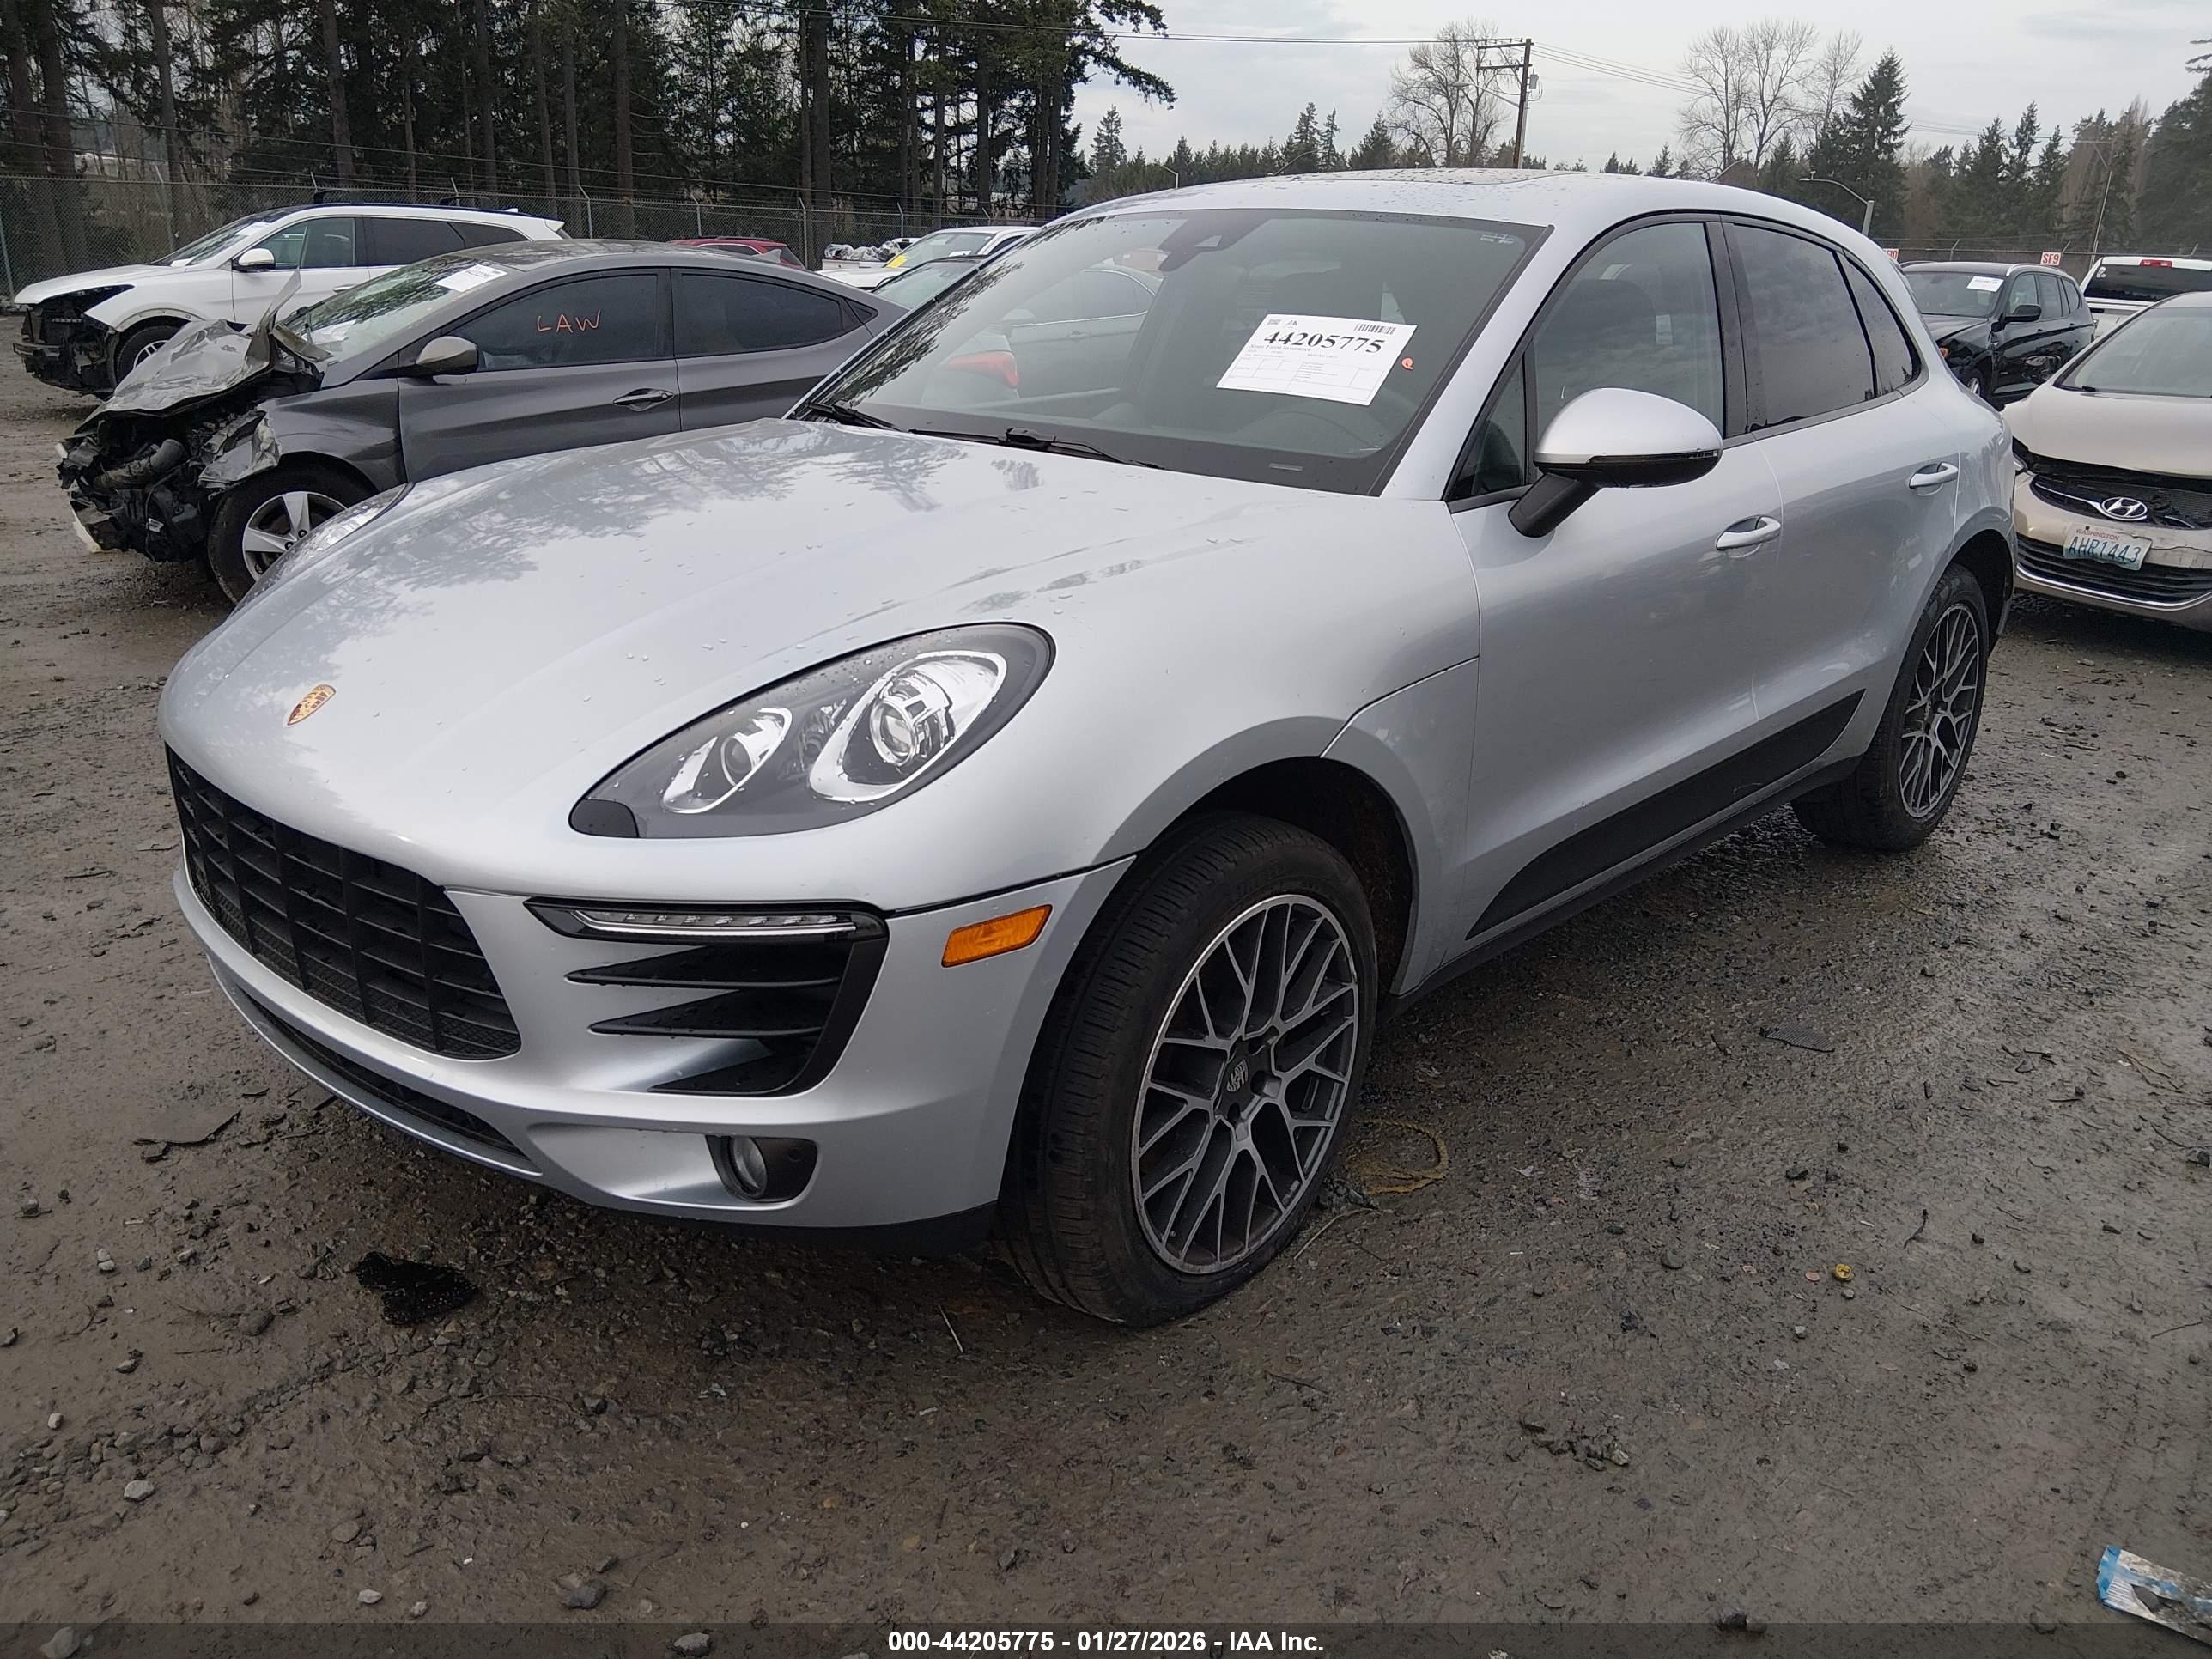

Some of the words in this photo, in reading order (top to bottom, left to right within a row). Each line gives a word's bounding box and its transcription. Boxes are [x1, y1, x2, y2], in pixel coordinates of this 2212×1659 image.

[2042, 253, 2060, 264] SF9
[537, 310, 601, 333] LAW
[1264, 331, 1386, 353] 44205775
[2069, 536, 2142, 563] AHR1443
